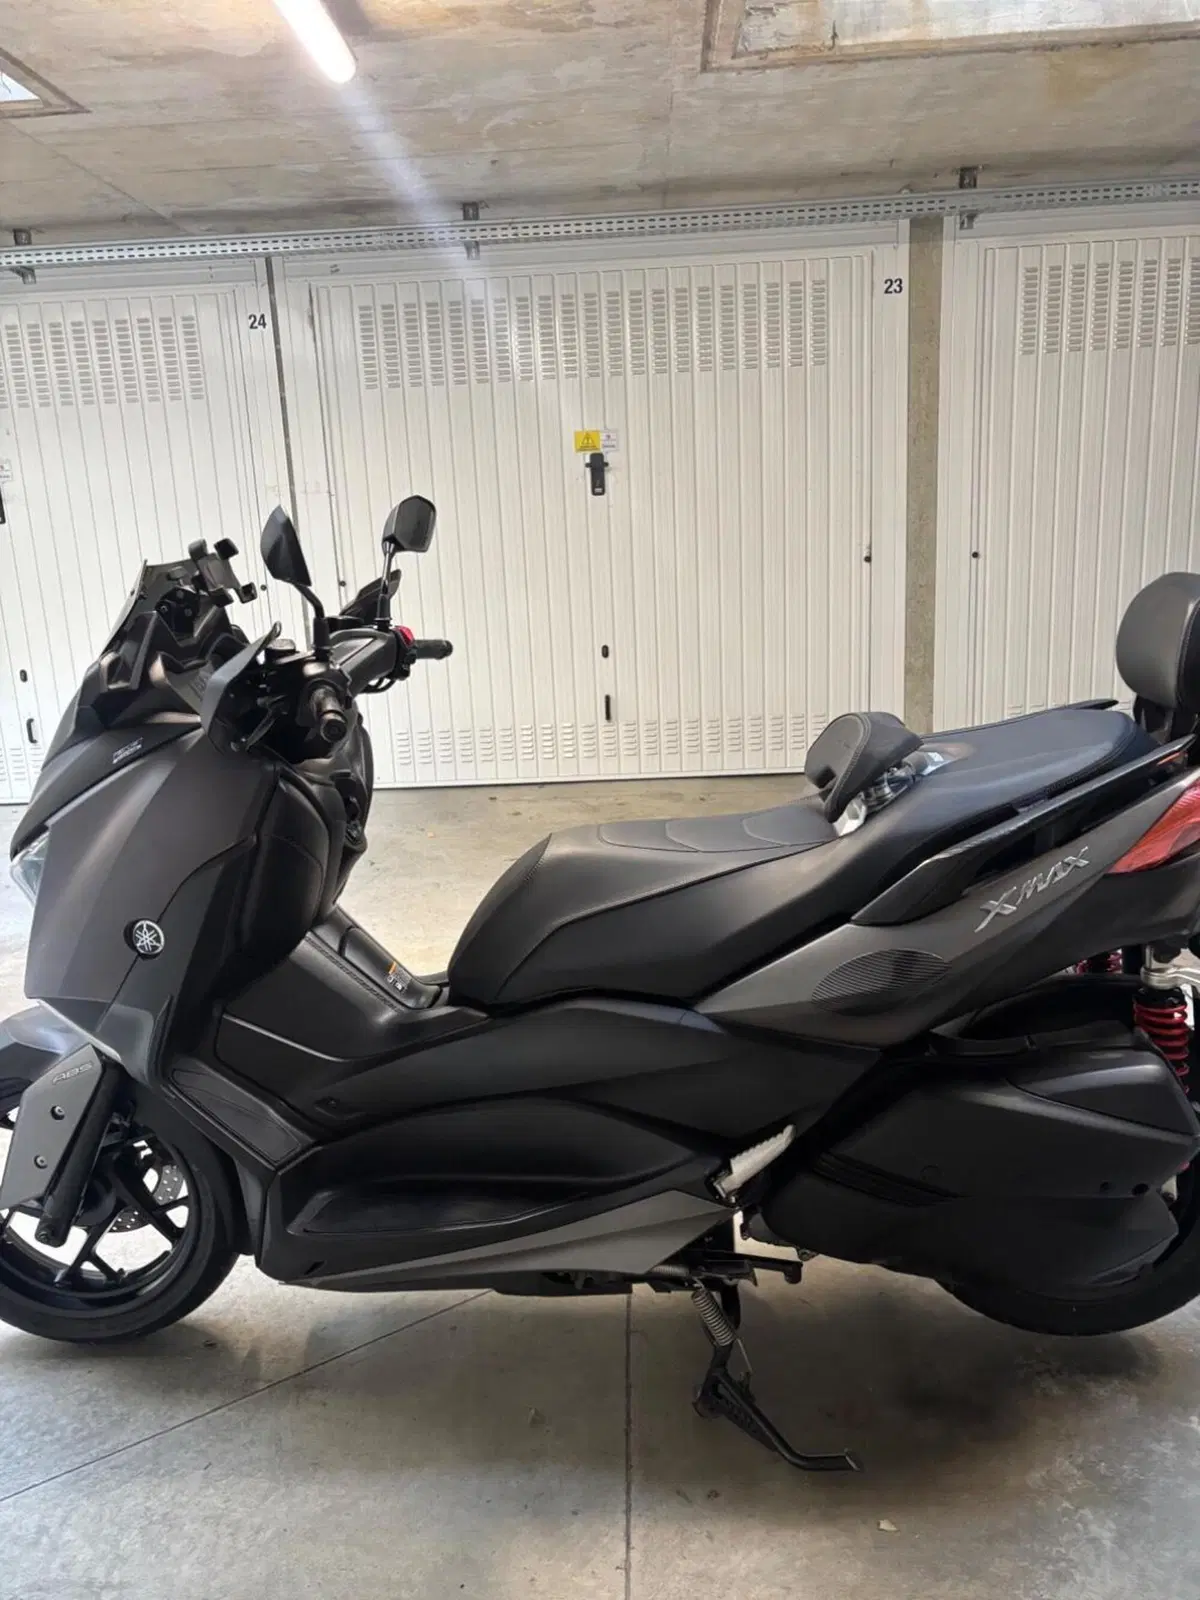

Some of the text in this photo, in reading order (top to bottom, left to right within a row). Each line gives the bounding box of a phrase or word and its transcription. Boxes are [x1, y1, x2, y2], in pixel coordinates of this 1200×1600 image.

[884, 278, 903, 294] 23
[248, 313, 267, 330] 24
[974, 846, 1090, 933] XMAX
[52, 1061, 94, 1085] ABS
